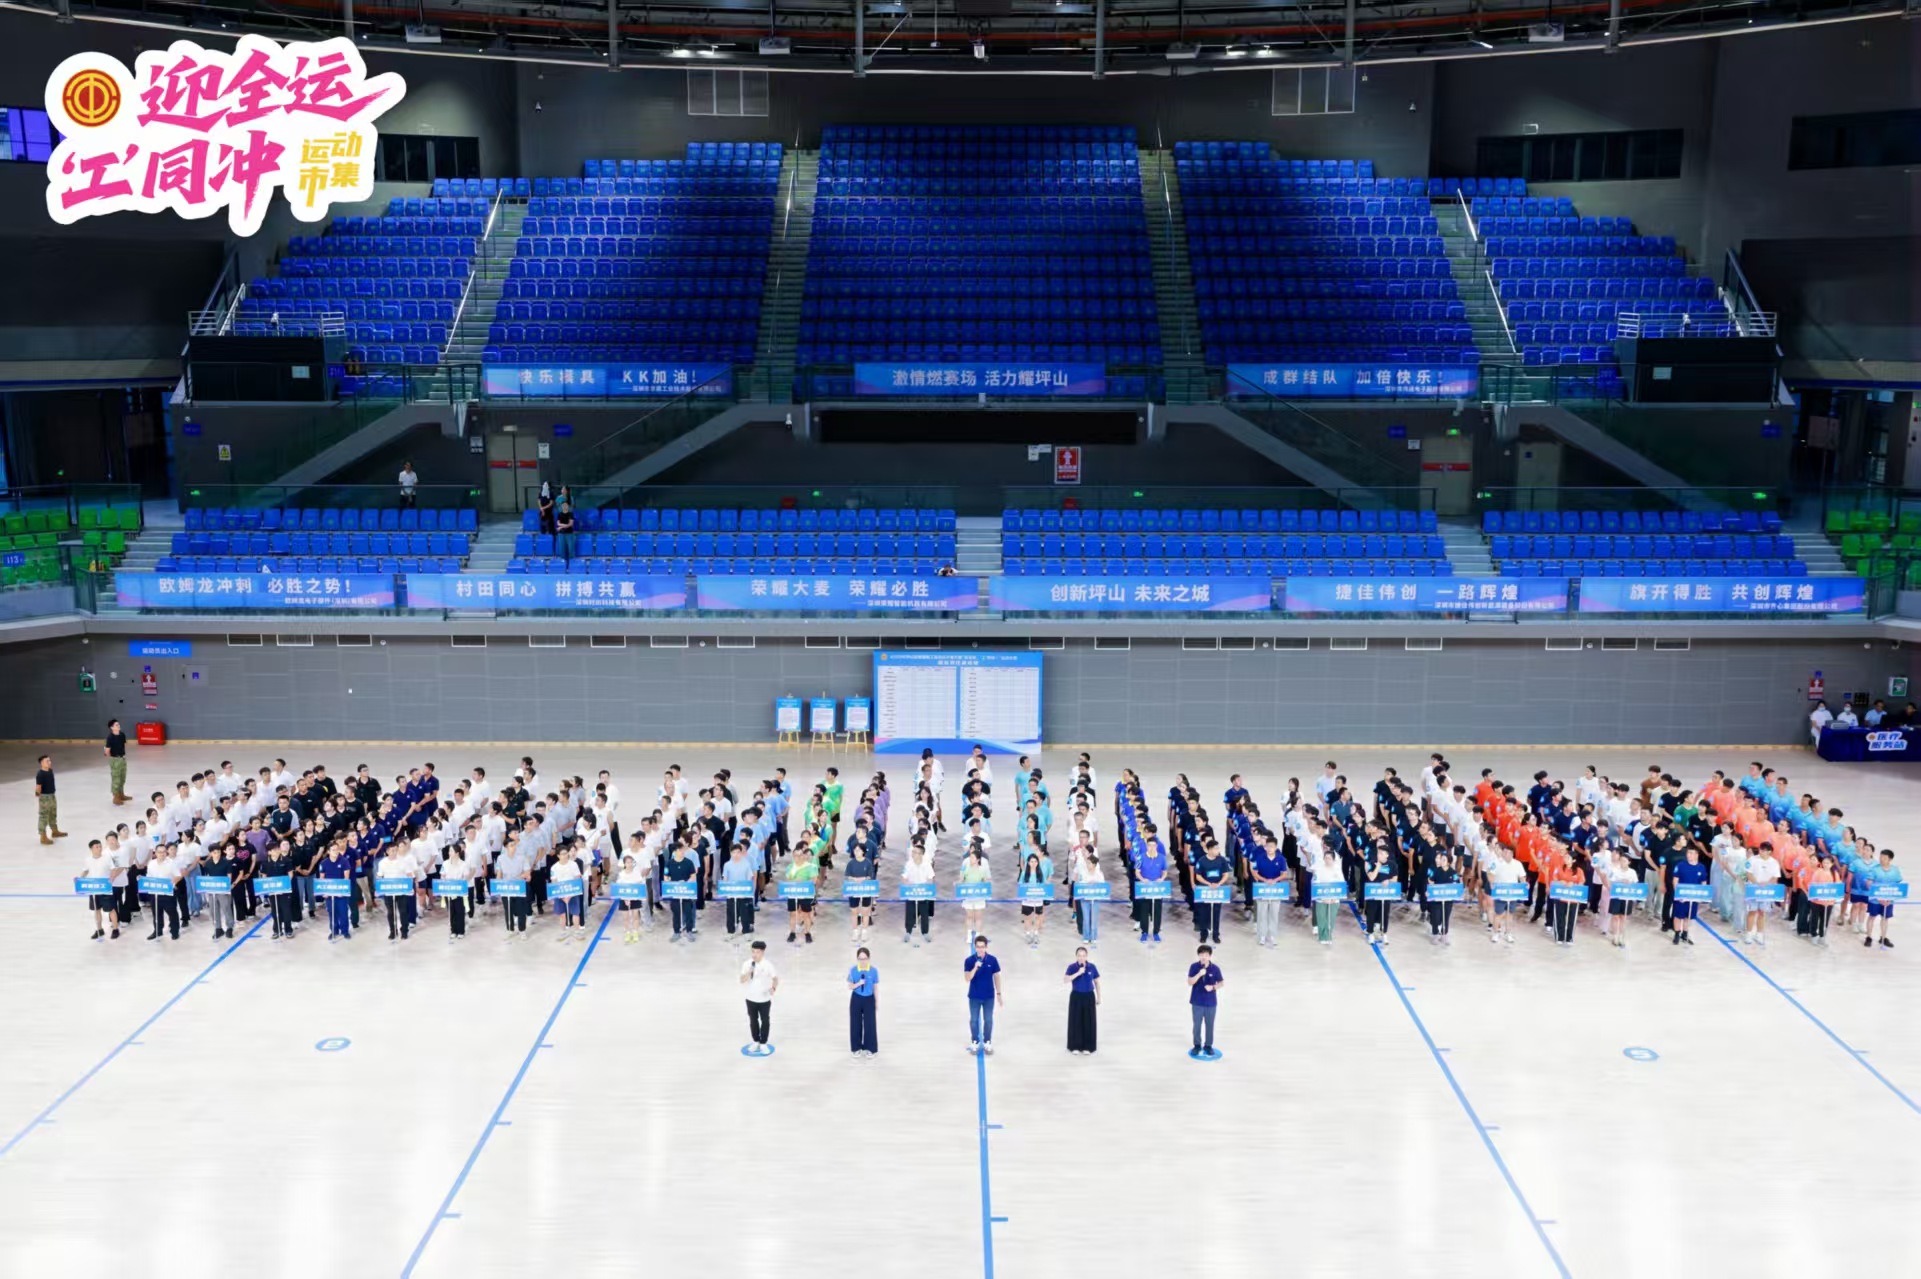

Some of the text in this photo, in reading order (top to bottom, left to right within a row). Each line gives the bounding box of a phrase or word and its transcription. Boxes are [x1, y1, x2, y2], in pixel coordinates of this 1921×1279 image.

[892, 370, 1068, 387] 激情燃赛场 活力耀坪山
[1263, 369, 1338, 385] 成群结队
[159, 578, 252, 594] 欧姆龙冲刺
[456, 580, 636, 598] 村田同心 拼搏共赢
[751, 579, 929, 597] 荣耀大麦 荣耀必胜
[1050, 583, 1210, 602] 创新坪山 未来之城
[1335, 583, 1519, 600] 捷佳伟创 一路辉煌
[1629, 583, 1814, 600] 旗开得胜 共创辉煌
